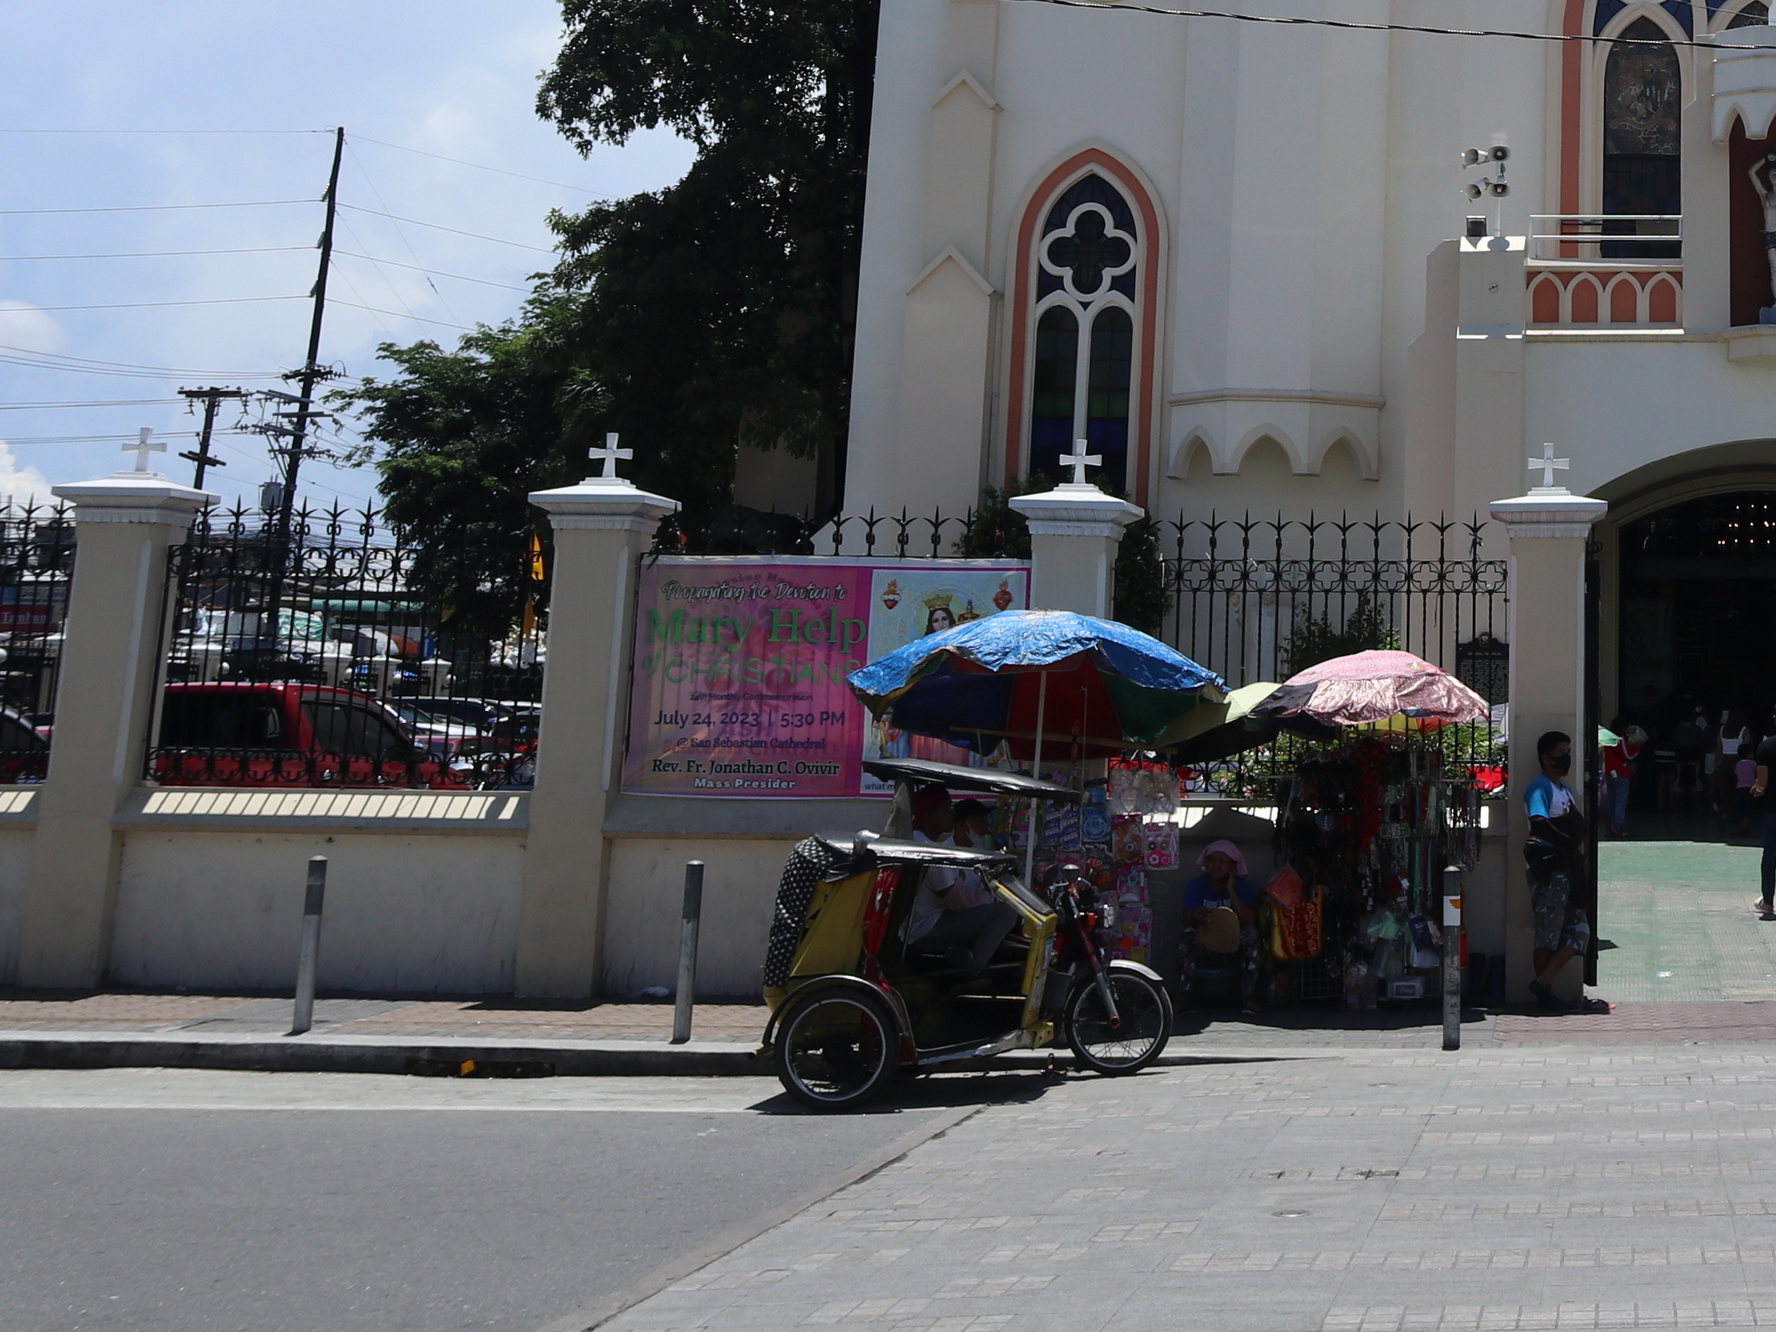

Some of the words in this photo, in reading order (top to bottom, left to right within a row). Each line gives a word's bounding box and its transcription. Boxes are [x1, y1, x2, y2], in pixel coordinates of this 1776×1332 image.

[661, 580, 745, 604] Propagating
[748, 582, 769, 600] the
[774, 583, 830, 600] Devotion
[834, 584, 848, 601] to
[645, 608, 756, 652] Mary
[768, 606, 867, 654] Help
[641, 647, 667, 678] of
[664, 658, 862, 685] CHRISTIANS
[709, 693, 741, 702] Monthly
[743, 693, 813, 701] Commemoration
[654, 710, 689, 729] July
[692, 712, 716, 727] 24,
[720, 712, 760, 727] 2023
[780, 712, 814, 727] 5:30
[819, 711, 845, 727] PM
[676, 737, 688, 749] @
[691, 737, 710, 748] San
[713, 737, 768, 749] Sebastian
[770, 737, 825, 749] Cathedral
[651, 759, 682, 773] Rev.
[686, 759, 706, 773] Fr.
[709, 760, 773, 776] Jonathan
[776, 761, 791, 775] C.
[795, 761, 840, 776] Ovivir
[694, 777, 731, 788] Mass
[734, 778, 796, 789] Presider
[864, 782, 885, 790] what
